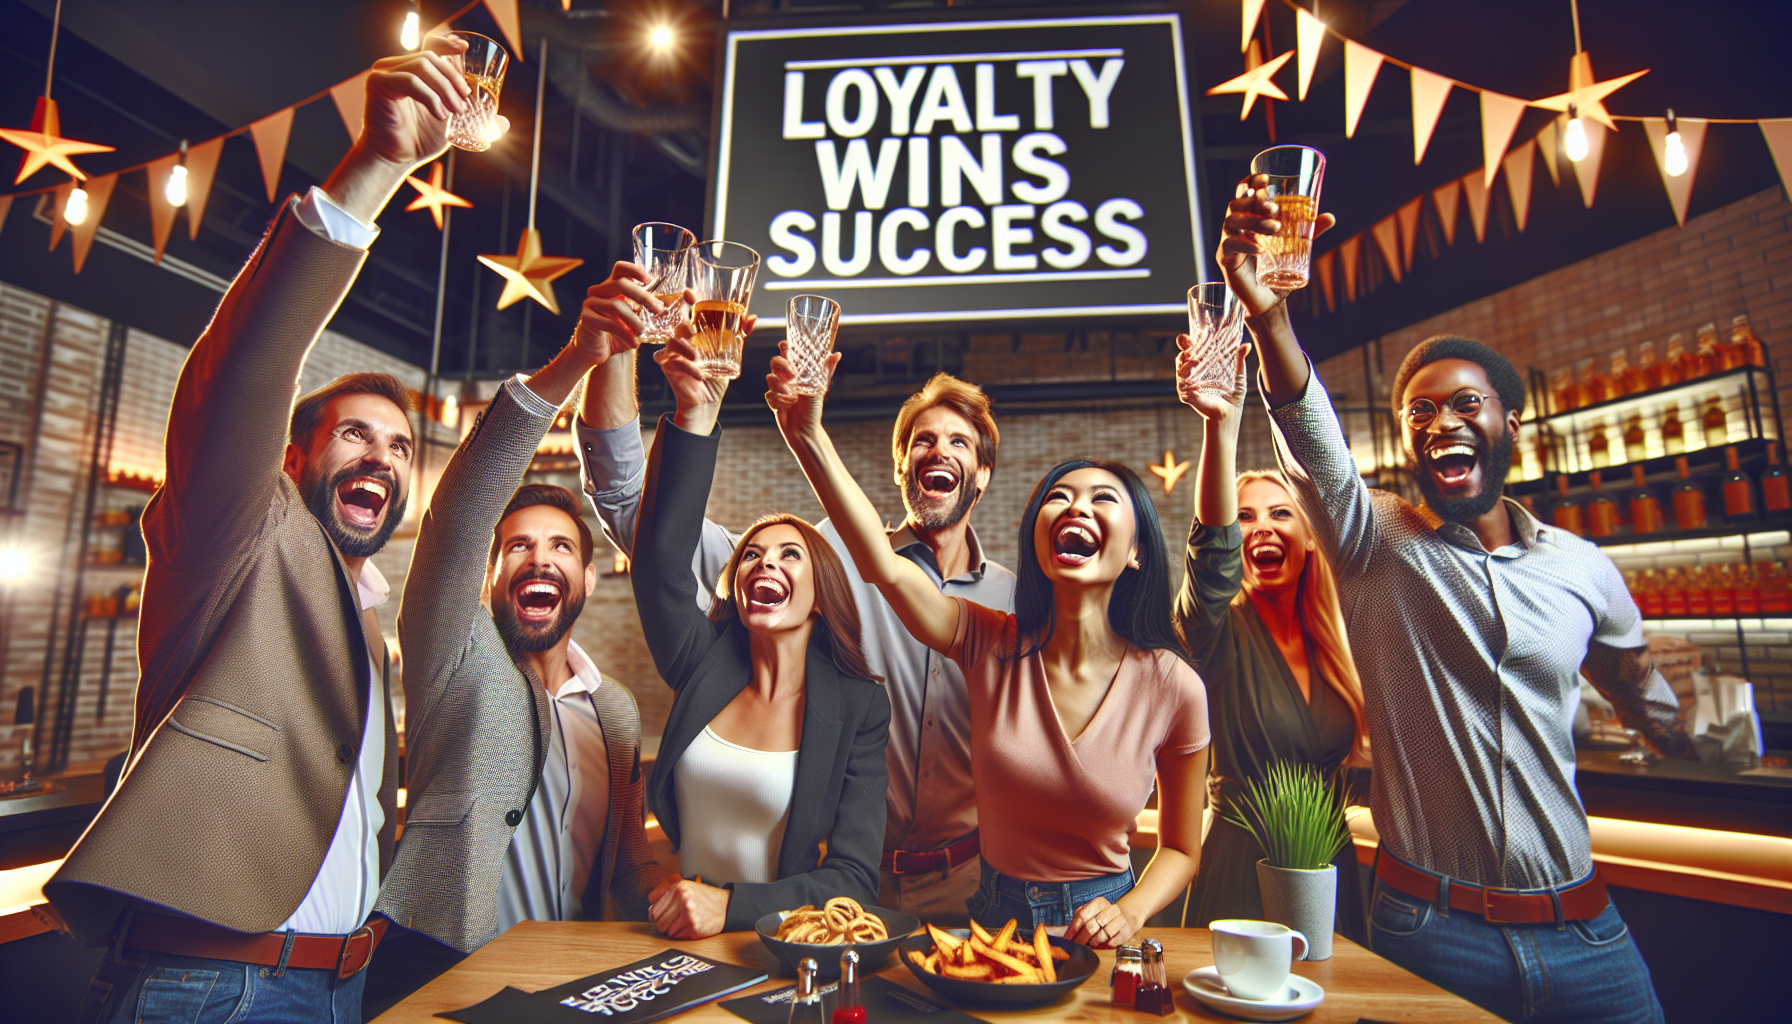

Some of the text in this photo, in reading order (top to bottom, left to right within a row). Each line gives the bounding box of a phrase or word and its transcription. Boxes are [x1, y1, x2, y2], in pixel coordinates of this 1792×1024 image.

[782, 59, 1125, 140] LOYALTY
[815, 132, 1071, 211] WINS
[766, 198, 1148, 278] SUCCESS
